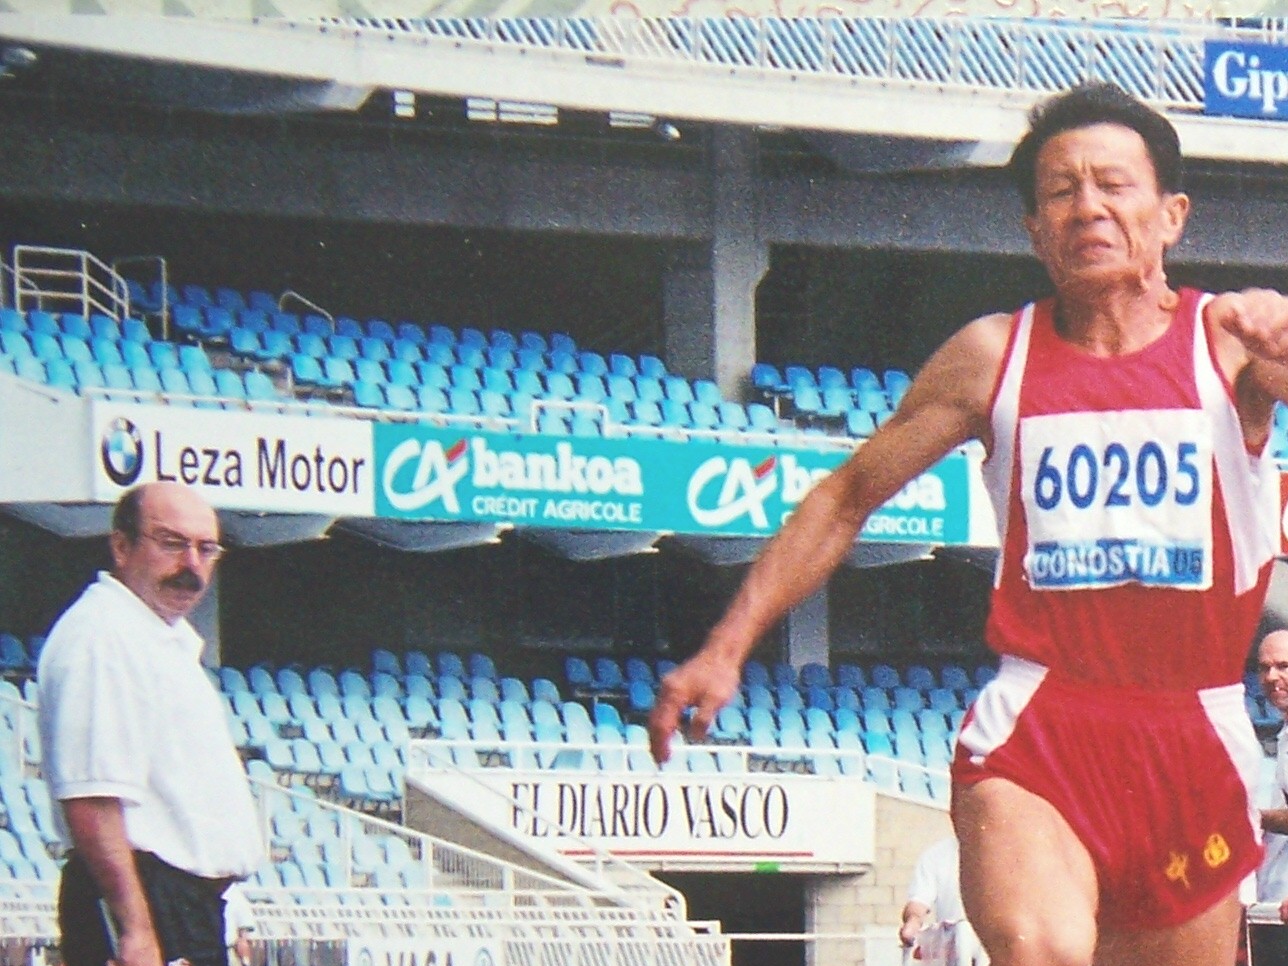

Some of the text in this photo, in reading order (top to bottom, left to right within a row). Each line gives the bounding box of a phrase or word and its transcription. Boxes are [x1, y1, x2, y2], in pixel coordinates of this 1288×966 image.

[154, 430, 365, 493] Leza Motor
[470, 436, 643, 496] bankoa
[1034, 441, 1201, 510] 60205
[543, 499, 643, 523] AGRICOLE
[512, 782, 789, 839] EL DIARIO VASCO
